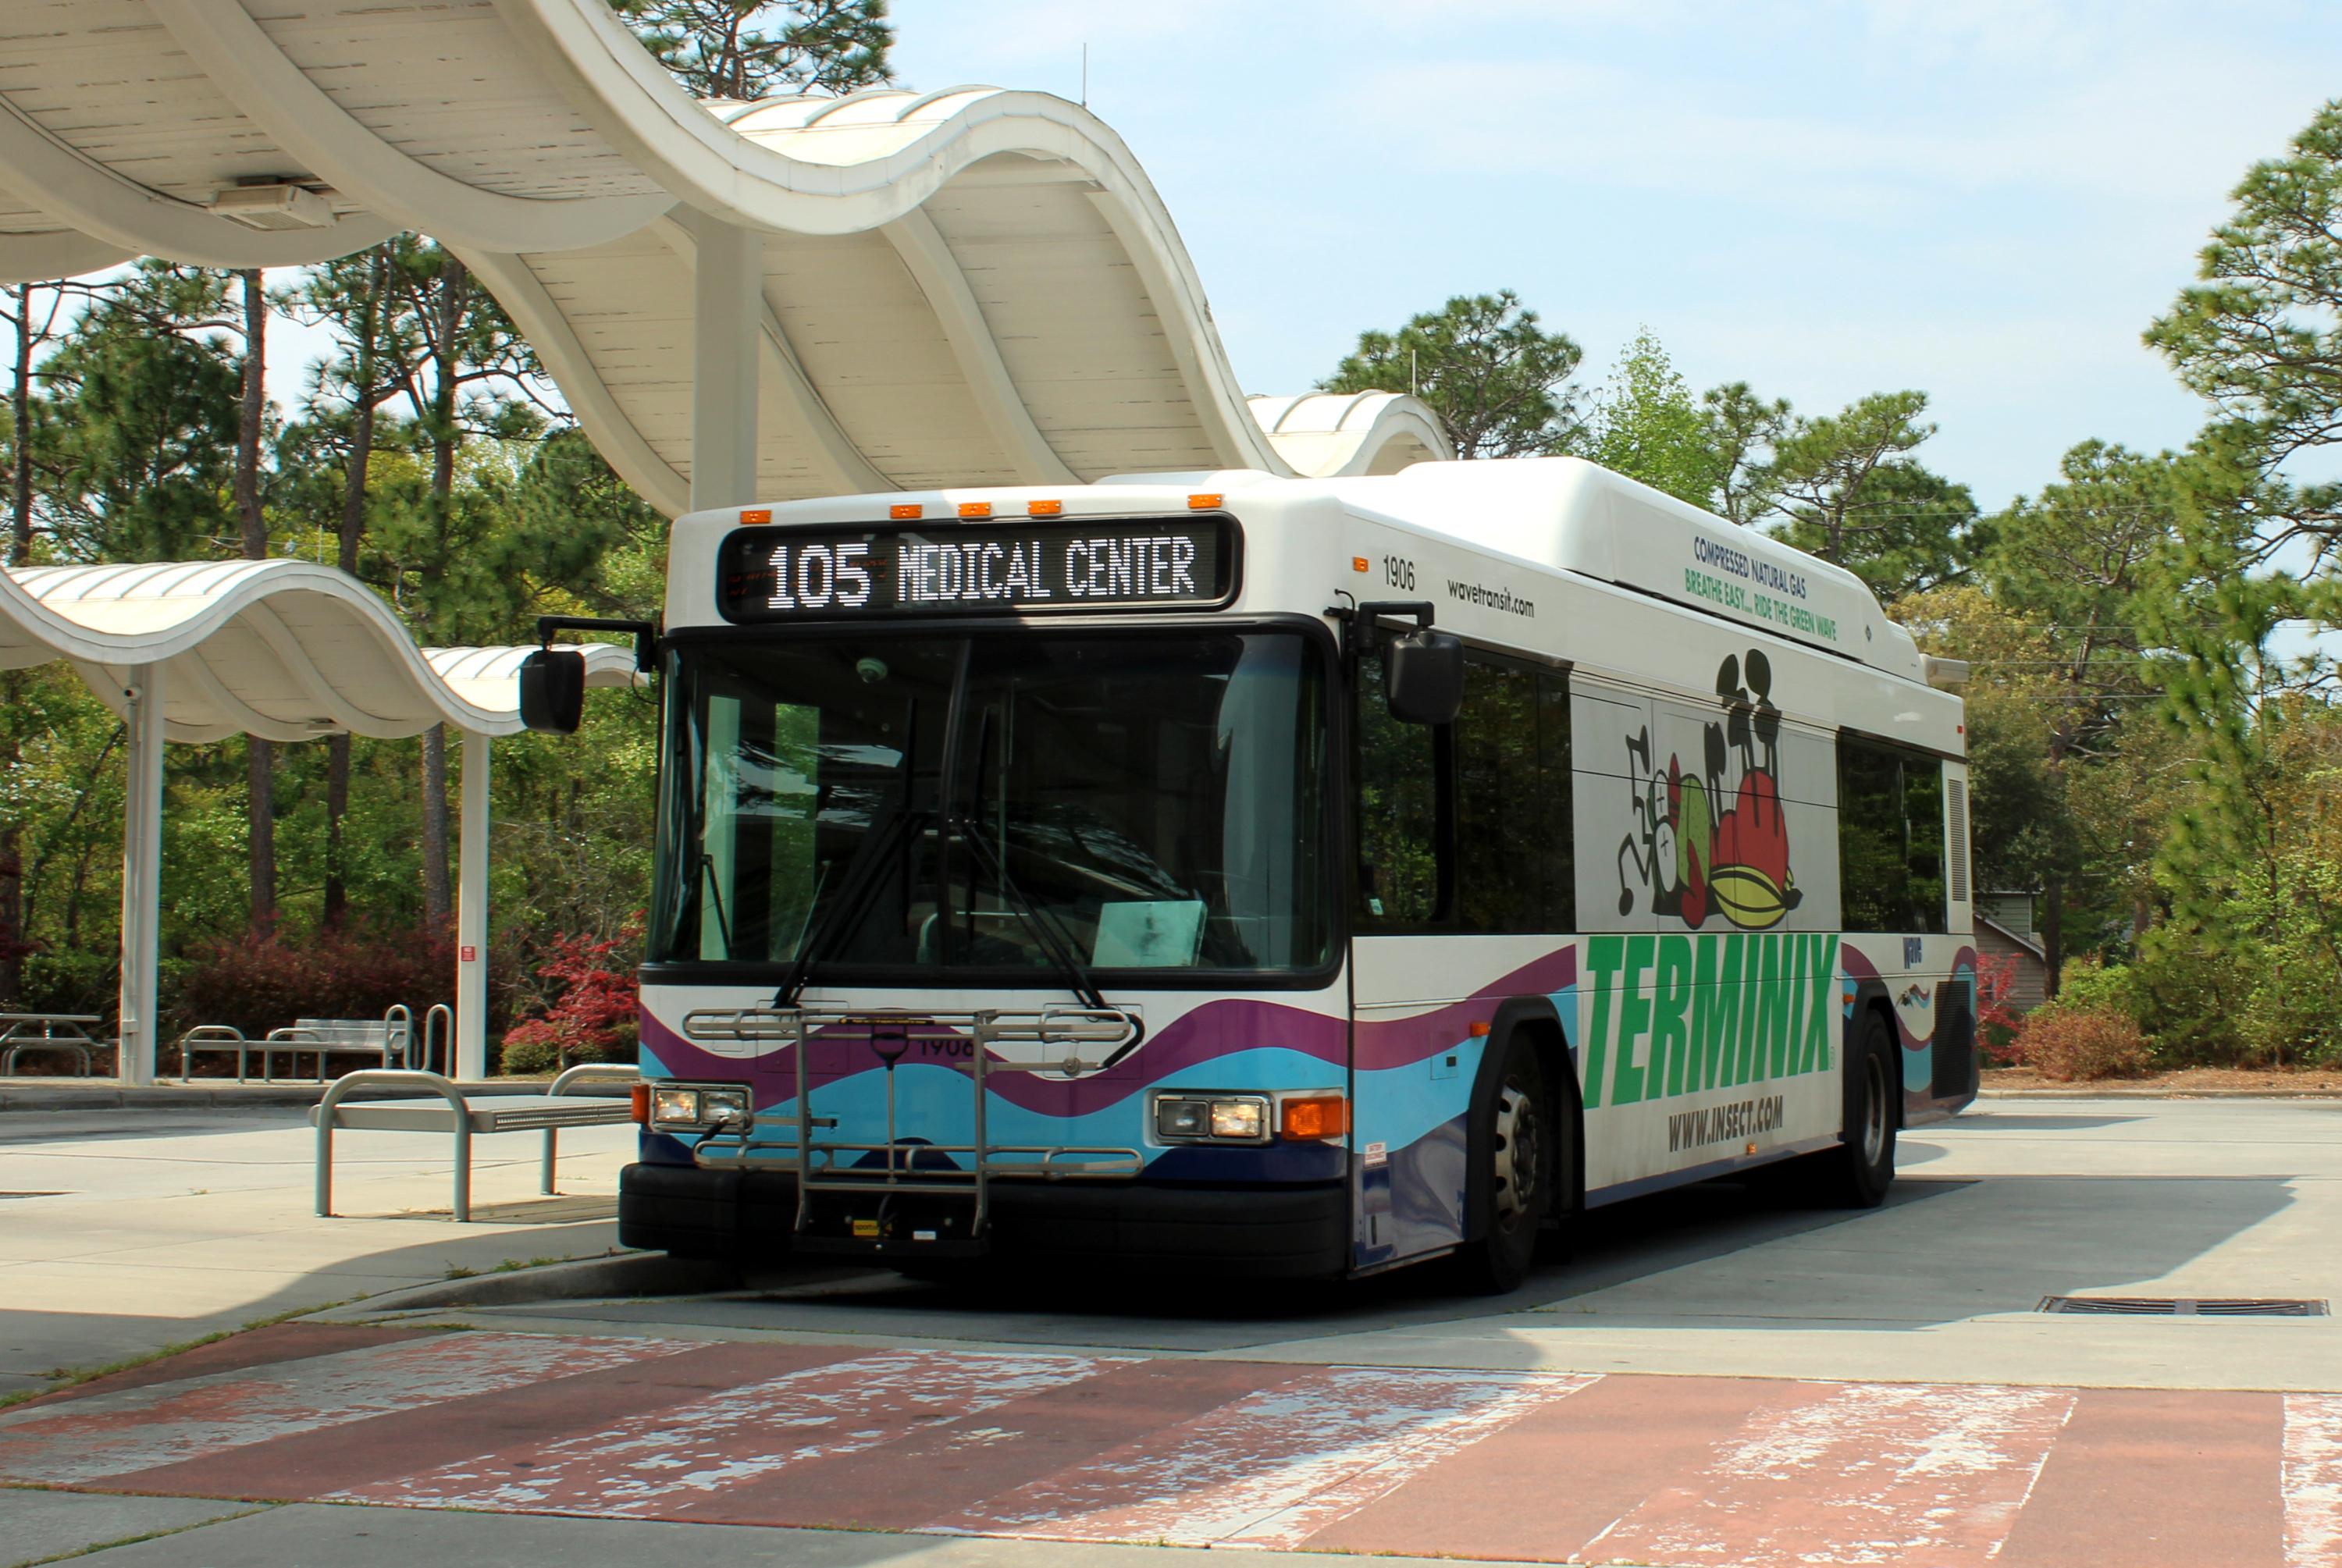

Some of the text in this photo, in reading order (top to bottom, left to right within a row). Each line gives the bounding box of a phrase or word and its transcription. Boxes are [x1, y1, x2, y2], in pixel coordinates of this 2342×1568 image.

[768, 543, 870, 608] 105
[899, 541, 1051, 601] MEDICAL
[1066, 536, 1195, 596] CENTER
[1383, 554, 1415, 592] 1906
[1693, 536, 1806, 599] COMPRESSED NATURAL GAS
[1447, 579, 1534, 618] wavetransit.com
[1685, 568, 1722, 603] BREATHE
[1754, 593, 1772, 620] RIDE
[1774, 599, 1788, 624] THE
[1789, 605, 1814, 634] GREEN
[1815, 614, 1837, 642] WAVE
[917, 1038, 973, 1057] 1906
[1582, 933, 1838, 1109] TERMINIX
[1668, 1095, 1783, 1153] WWW.INSECT.COM
